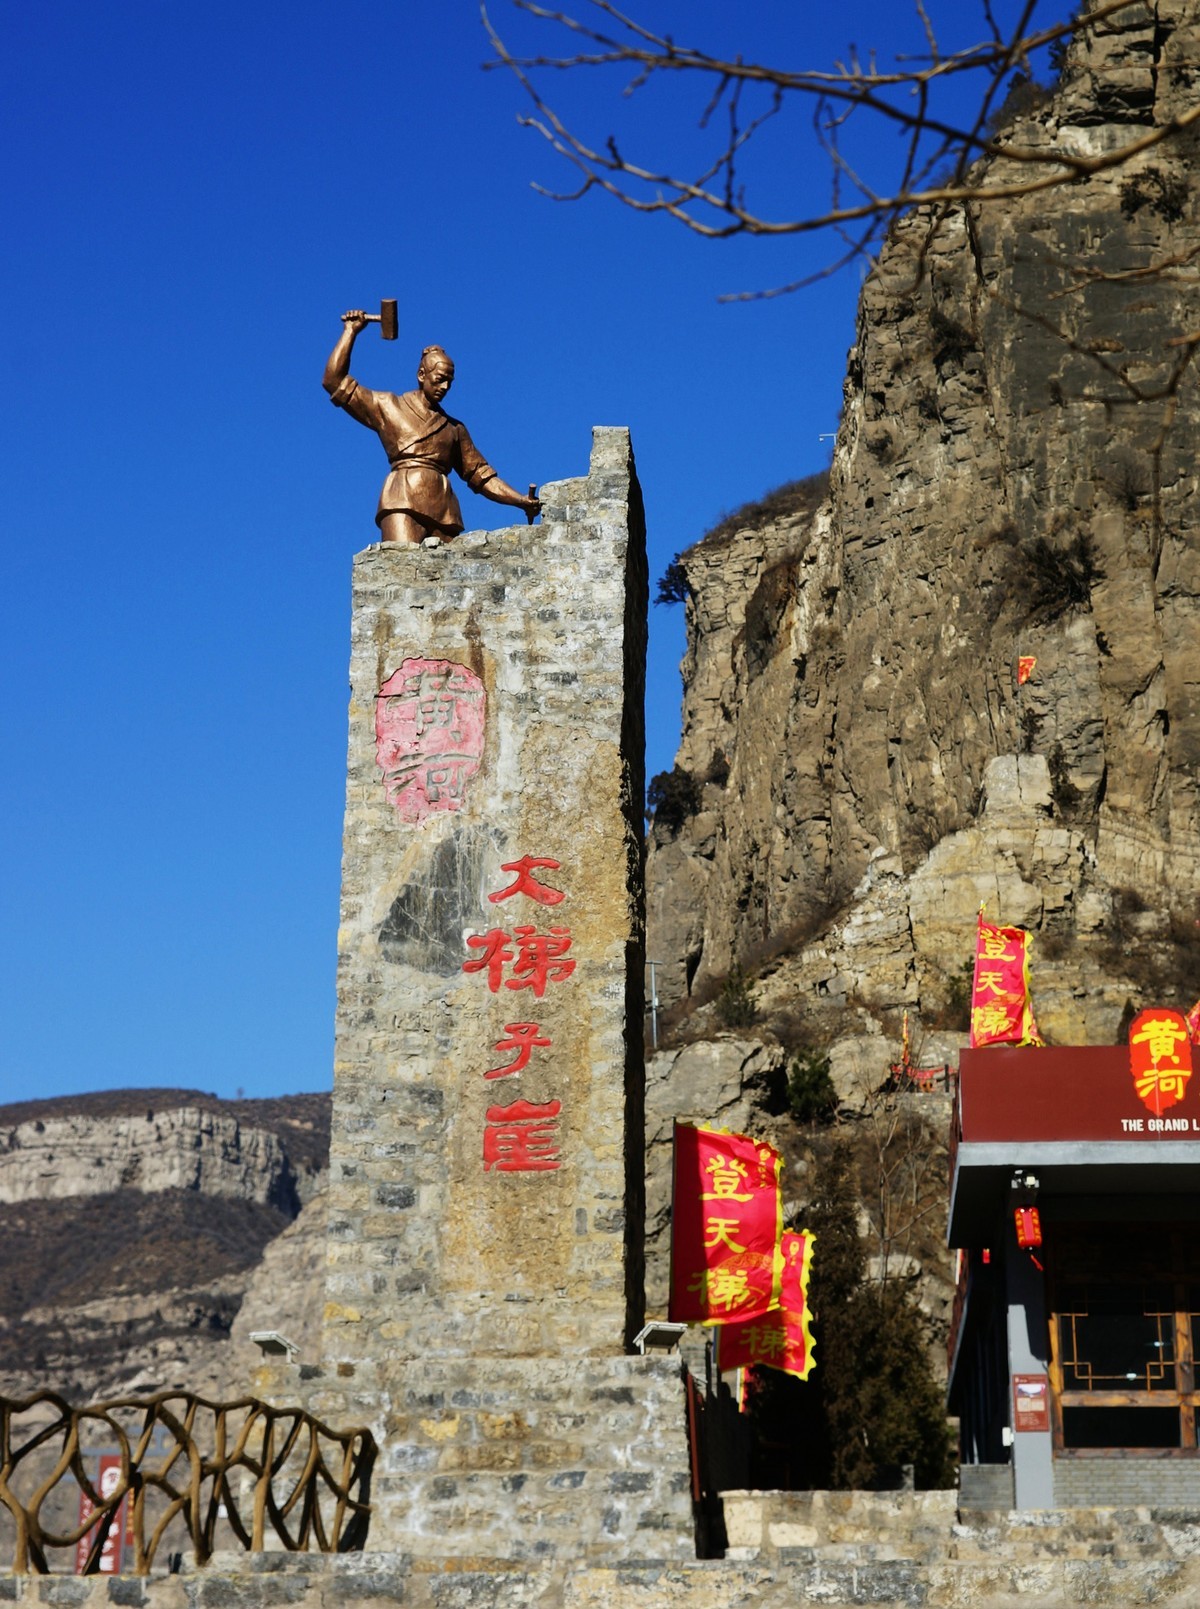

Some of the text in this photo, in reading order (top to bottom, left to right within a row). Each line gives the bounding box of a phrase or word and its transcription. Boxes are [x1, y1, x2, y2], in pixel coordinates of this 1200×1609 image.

[462, 854, 577, 1172] 大梯子崖
[971, 927, 1017, 1037] 登天梯
[1132, 1018, 1192, 1100] 黄河
[1121, 1118, 1144, 1132] THE
[1147, 1118, 1189, 1132] GRAND
[686, 1154, 755, 1312] 登天梯
